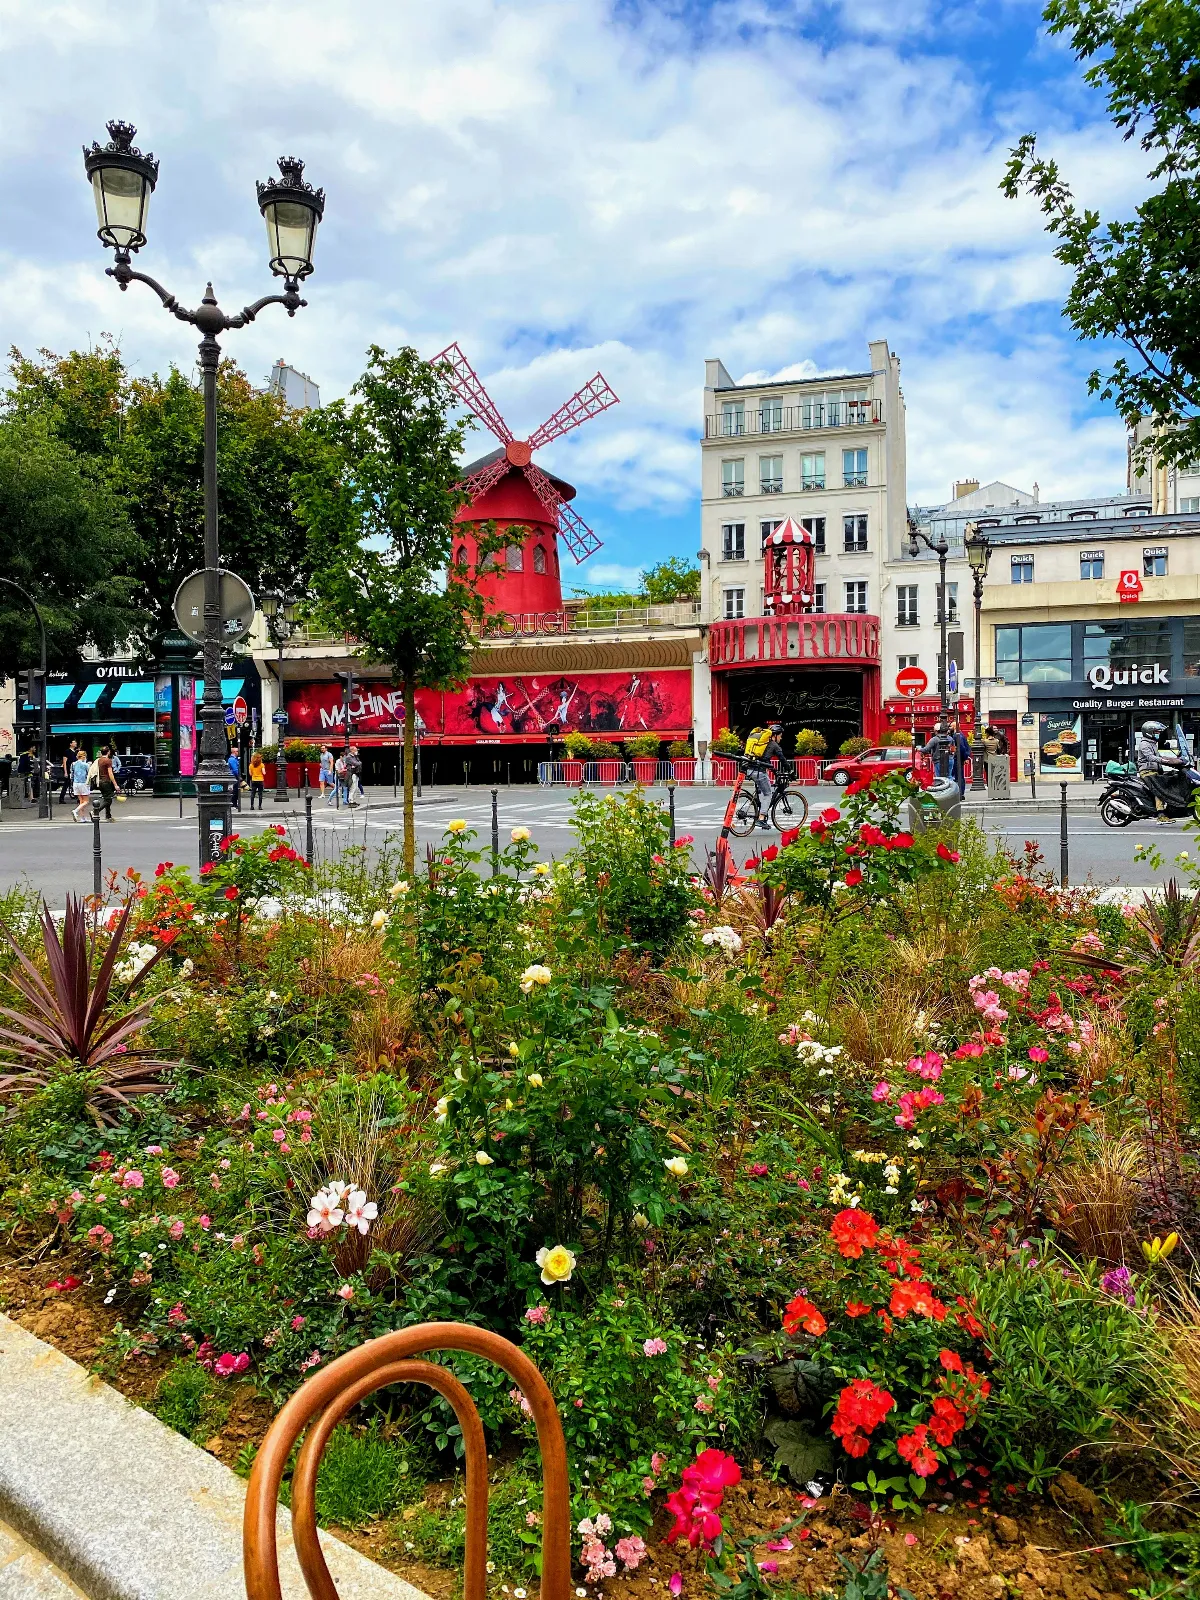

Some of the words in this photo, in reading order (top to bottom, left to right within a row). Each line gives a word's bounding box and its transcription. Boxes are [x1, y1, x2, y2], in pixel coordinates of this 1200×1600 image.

[1081, 551, 1104, 559] Quick
[1143, 547, 1166, 555] Quick
[1011, 555, 1034, 563] Quick
[1123, 573, 1139, 589] Q
[709, 624, 788, 664] OULIN
[798, 620, 880, 659] ROUG
[1089, 662, 1170, 691] Quick
[1072, 700, 1103, 710] Quality
[1106, 699, 1135, 709] Burger
[1138, 698, 1185, 707] Restaurant
[904, 716, 928, 724] TIKET
